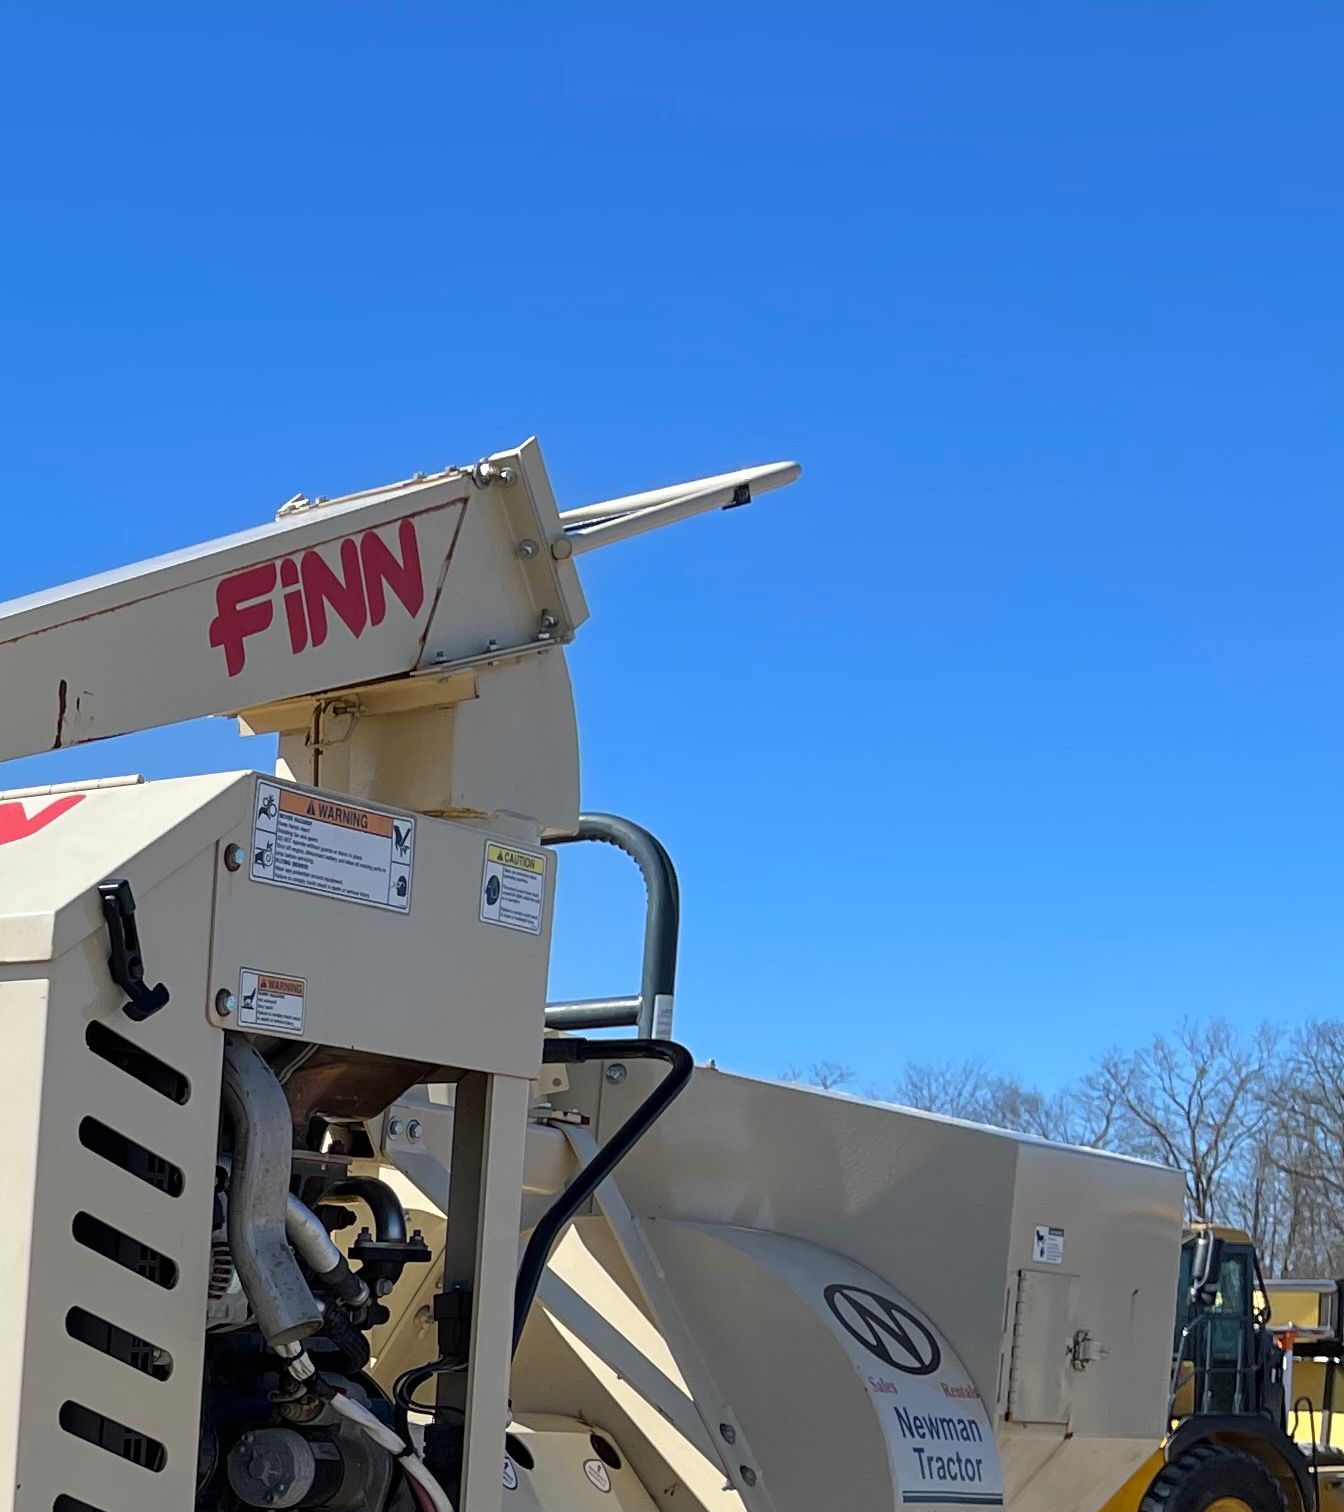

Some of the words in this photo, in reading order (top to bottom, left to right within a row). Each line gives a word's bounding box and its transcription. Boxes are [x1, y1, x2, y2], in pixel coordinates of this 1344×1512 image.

[318, 803, 368, 829] WARNING
[504, 852, 536, 870] CAUTION
[268, 980, 302, 994] WARNING
[868, 1376, 898, 1394] Sales
[894, 1406, 983, 1443] Newman
[912, 1447, 983, 1483] Tractor
